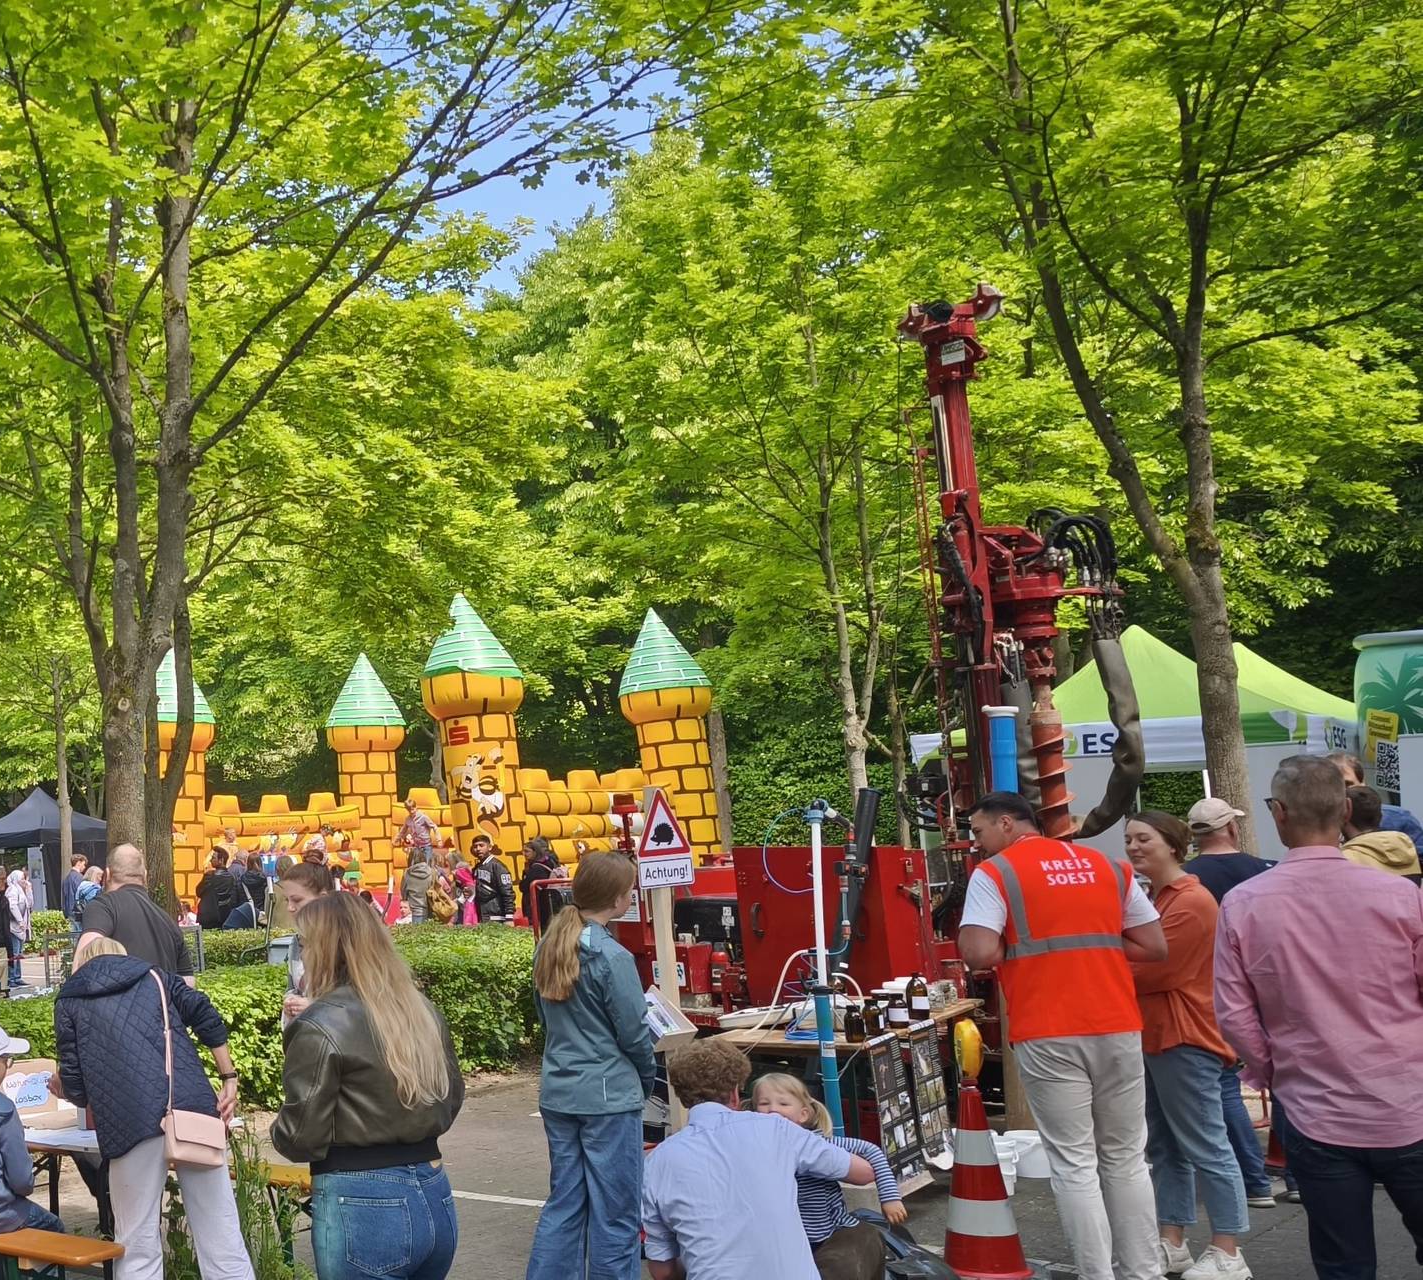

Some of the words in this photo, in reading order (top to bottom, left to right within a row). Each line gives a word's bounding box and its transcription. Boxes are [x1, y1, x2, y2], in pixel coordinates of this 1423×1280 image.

[1082, 733, 1115, 754] ES
[1333, 725, 1347, 749] ESG
[645, 864, 688, 880] Achtung!
[1040, 858, 1092, 871] KREIS
[1046, 872, 1095, 886] SOEST
